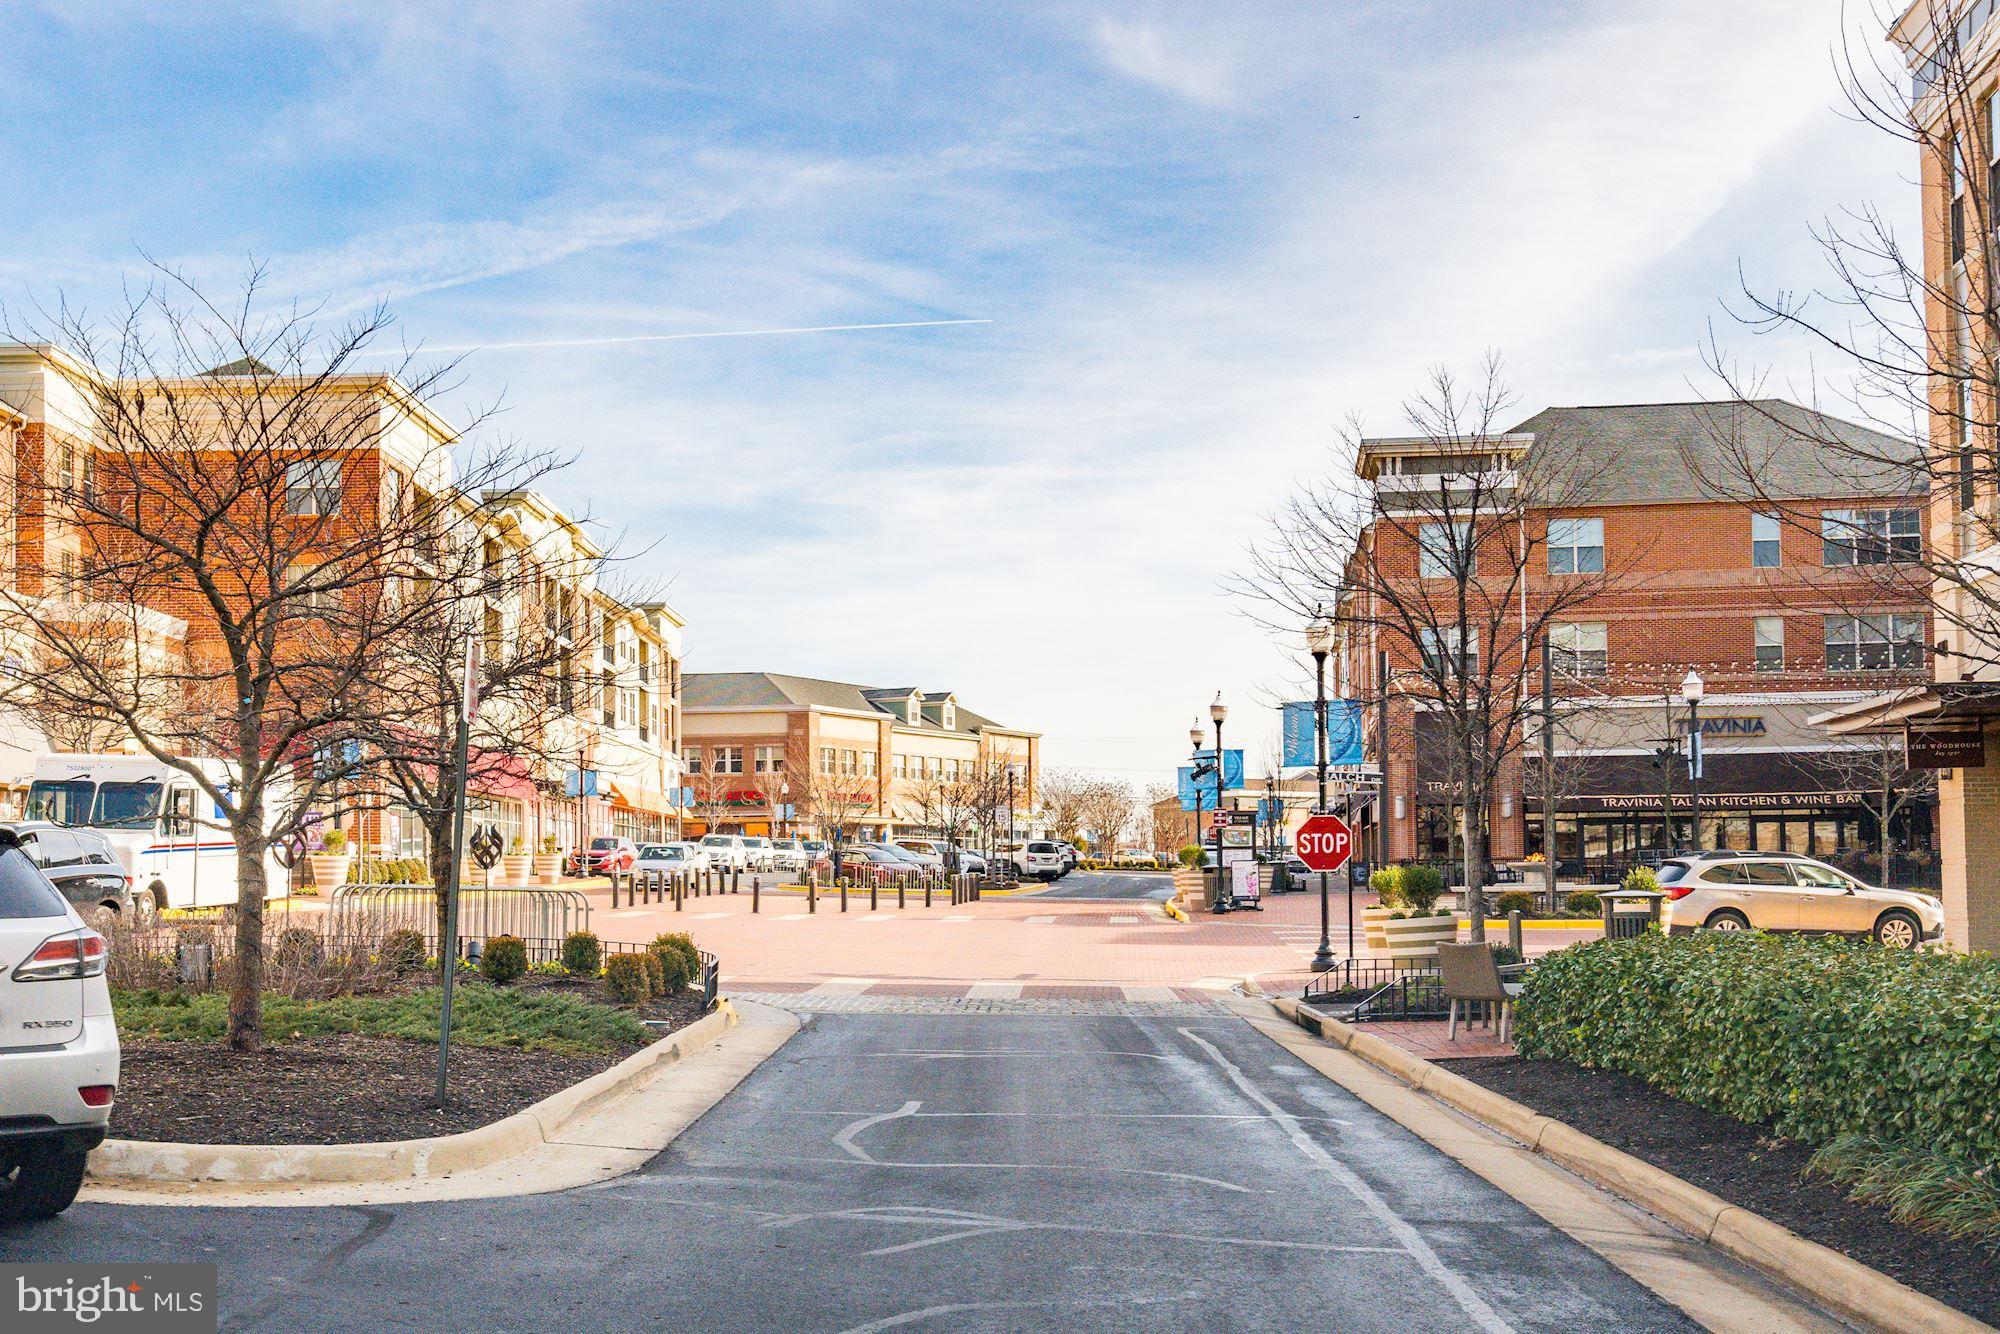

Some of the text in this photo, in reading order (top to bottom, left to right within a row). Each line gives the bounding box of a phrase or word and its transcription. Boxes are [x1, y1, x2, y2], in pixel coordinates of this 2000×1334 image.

[1287, 712, 1299, 758] Welcome
[1601, 798, 1663, 807] TRAVINIA
[1720, 796, 1777, 806] KITCHEN
[1780, 795, 1791, 805] &
[1794, 794, 1832, 804] WINE
[1299, 832, 1348, 854] STOP
[22, 1019, 73, 1029] RX 350
